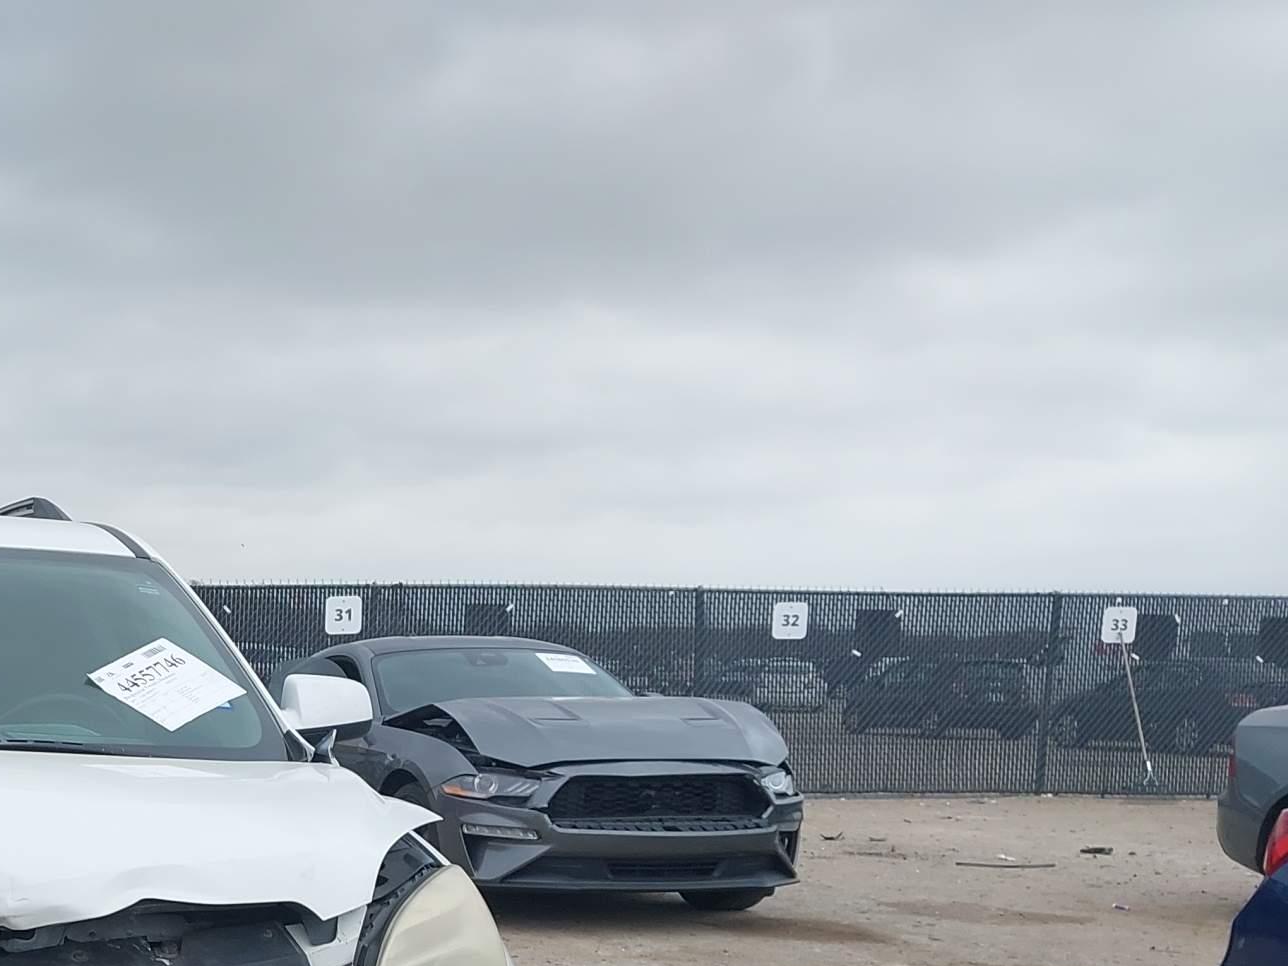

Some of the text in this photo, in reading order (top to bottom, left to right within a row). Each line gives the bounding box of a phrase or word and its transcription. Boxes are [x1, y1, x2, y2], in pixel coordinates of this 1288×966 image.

[334, 608, 352, 622] 31
[781, 614, 800, 627] 32
[1111, 618, 1128, 631] 33
[117, 653, 186, 693] 44557746
